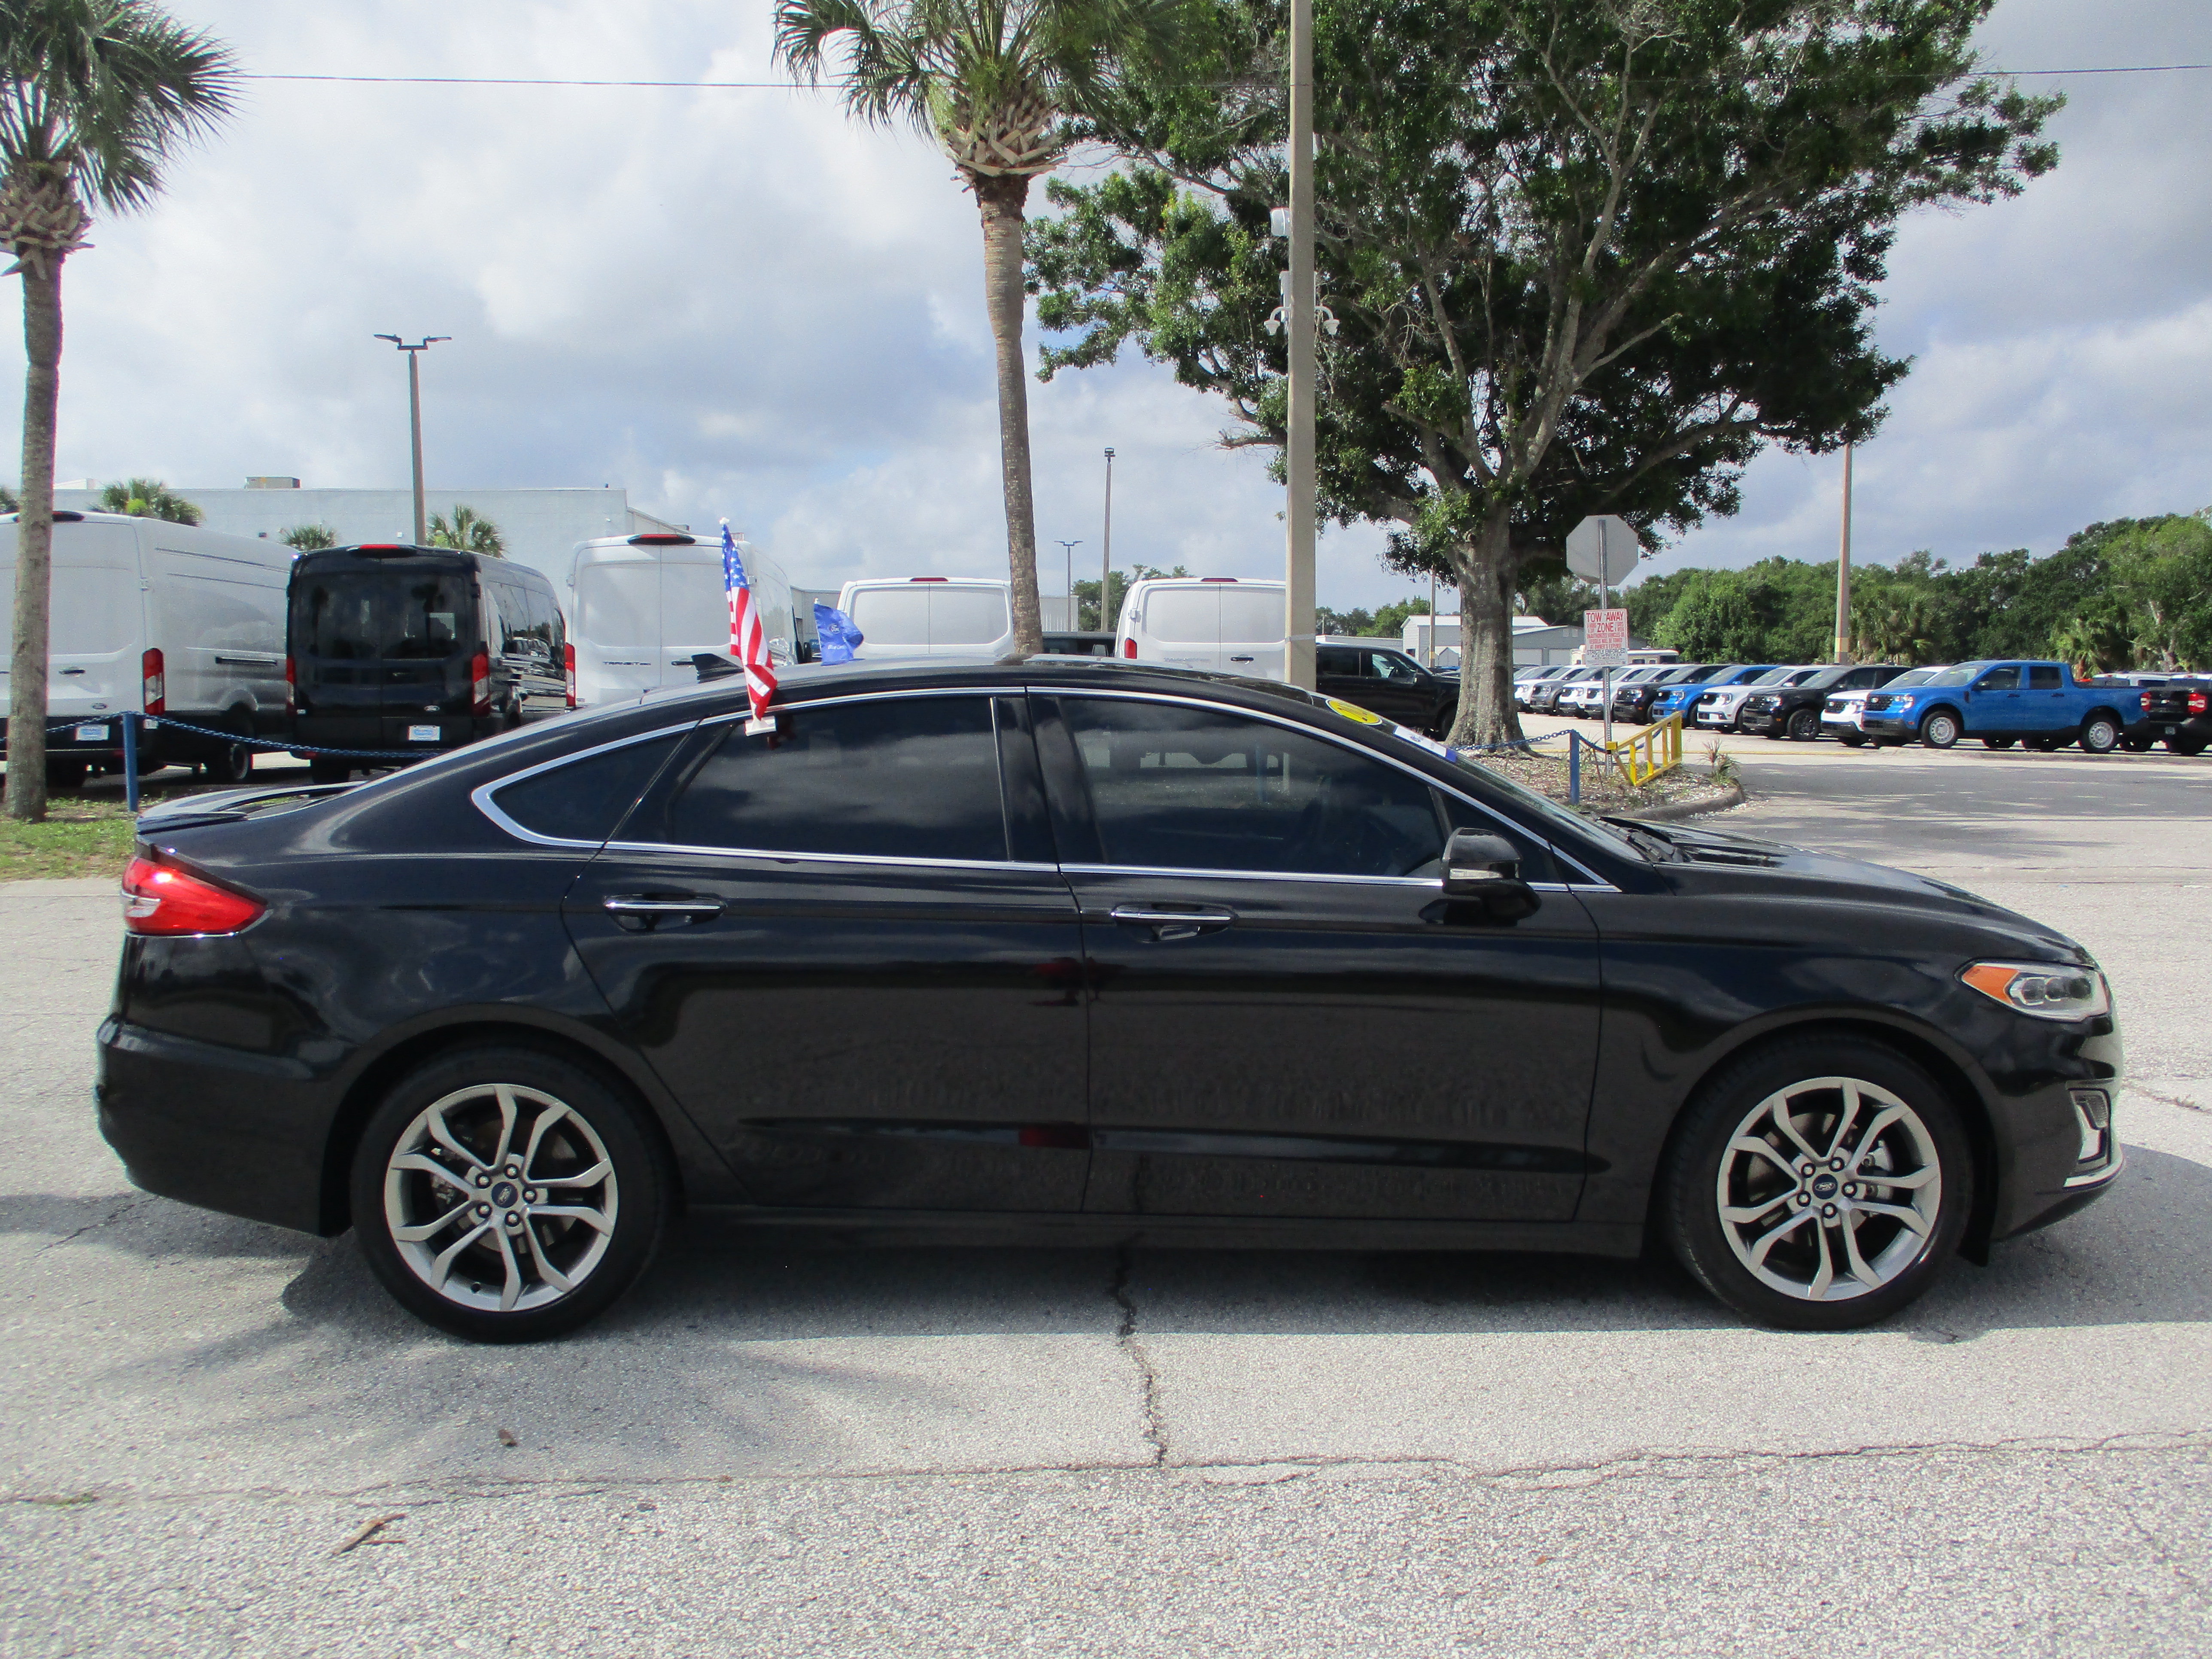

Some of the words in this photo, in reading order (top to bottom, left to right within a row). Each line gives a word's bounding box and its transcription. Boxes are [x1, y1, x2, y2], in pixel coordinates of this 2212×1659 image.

[1586, 612, 1602, 622] TOW
[1606, 611, 1623, 621] AWAY
[1597, 623, 1614, 632] ZONE
